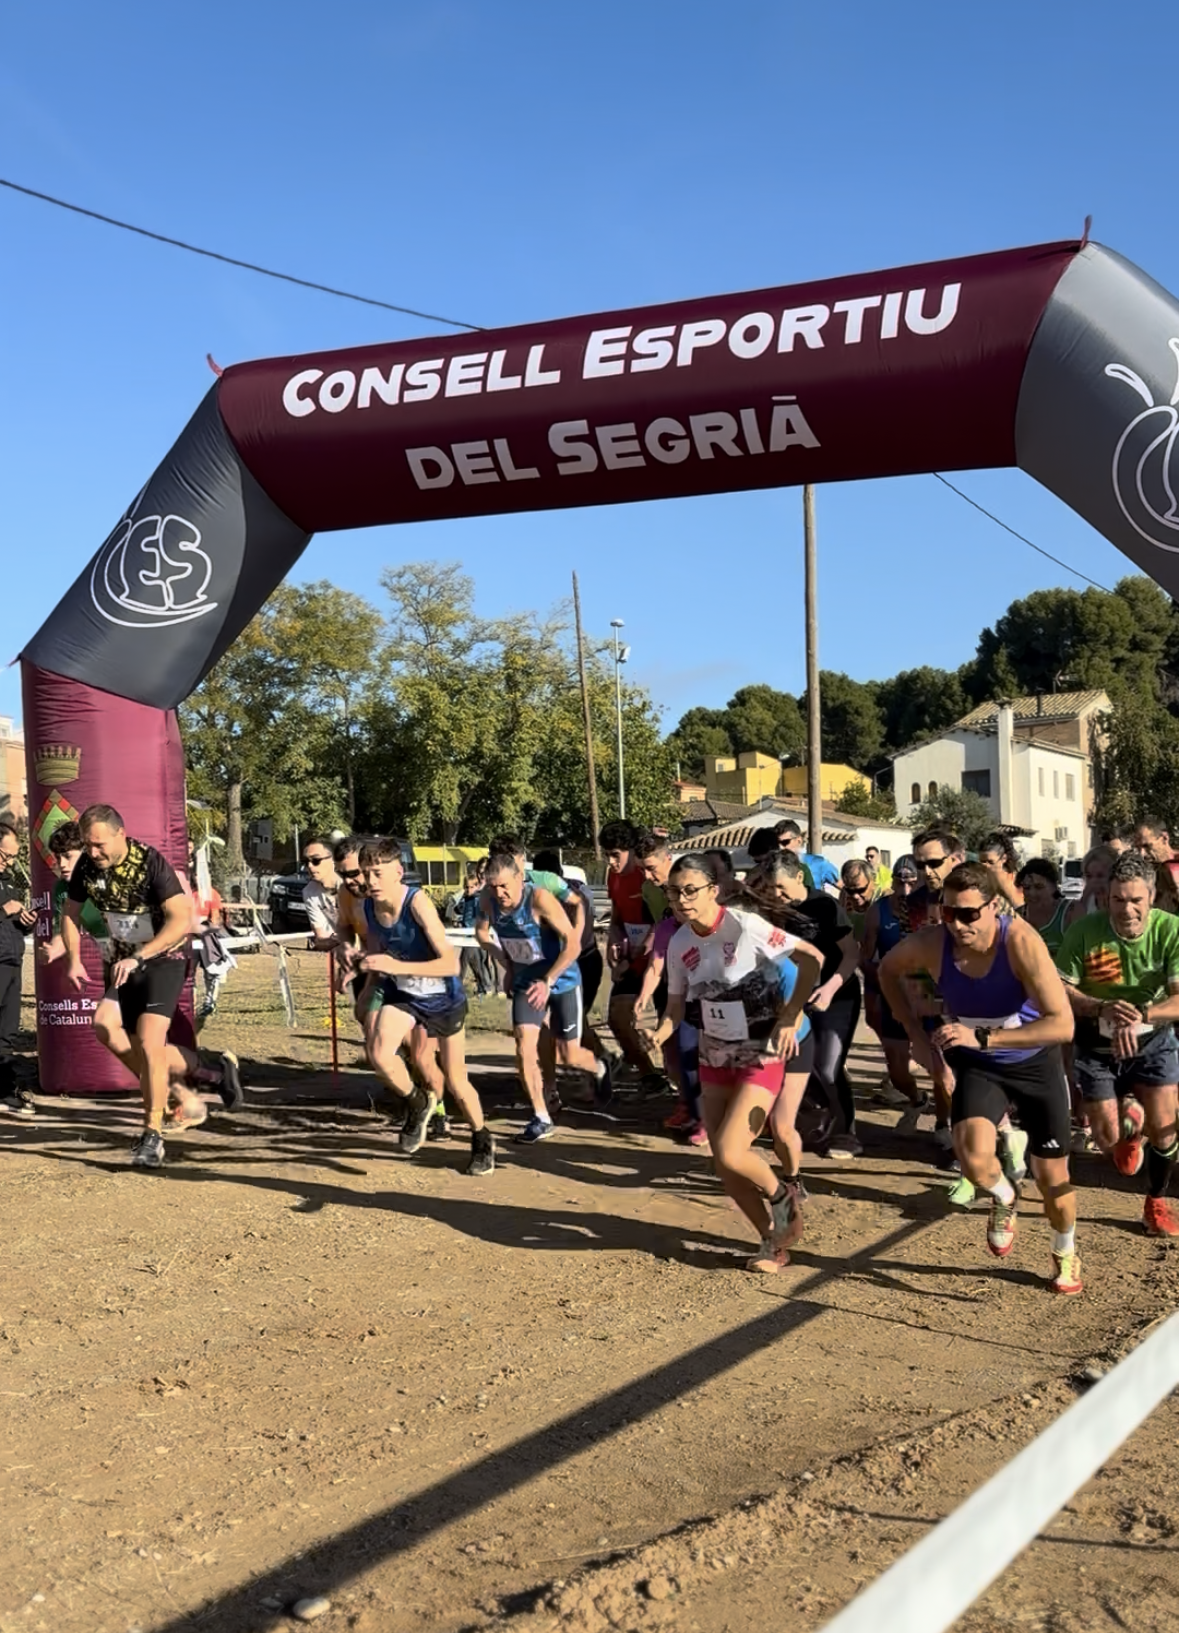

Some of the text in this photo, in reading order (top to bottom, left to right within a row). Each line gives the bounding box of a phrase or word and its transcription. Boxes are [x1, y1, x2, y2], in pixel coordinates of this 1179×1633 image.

[283, 282, 961, 418] CONSELL ESPORTIU
[405, 438, 541, 490] DEL
[38, 999, 79, 1011] Consells
[710, 1007, 726, 1020] 11
